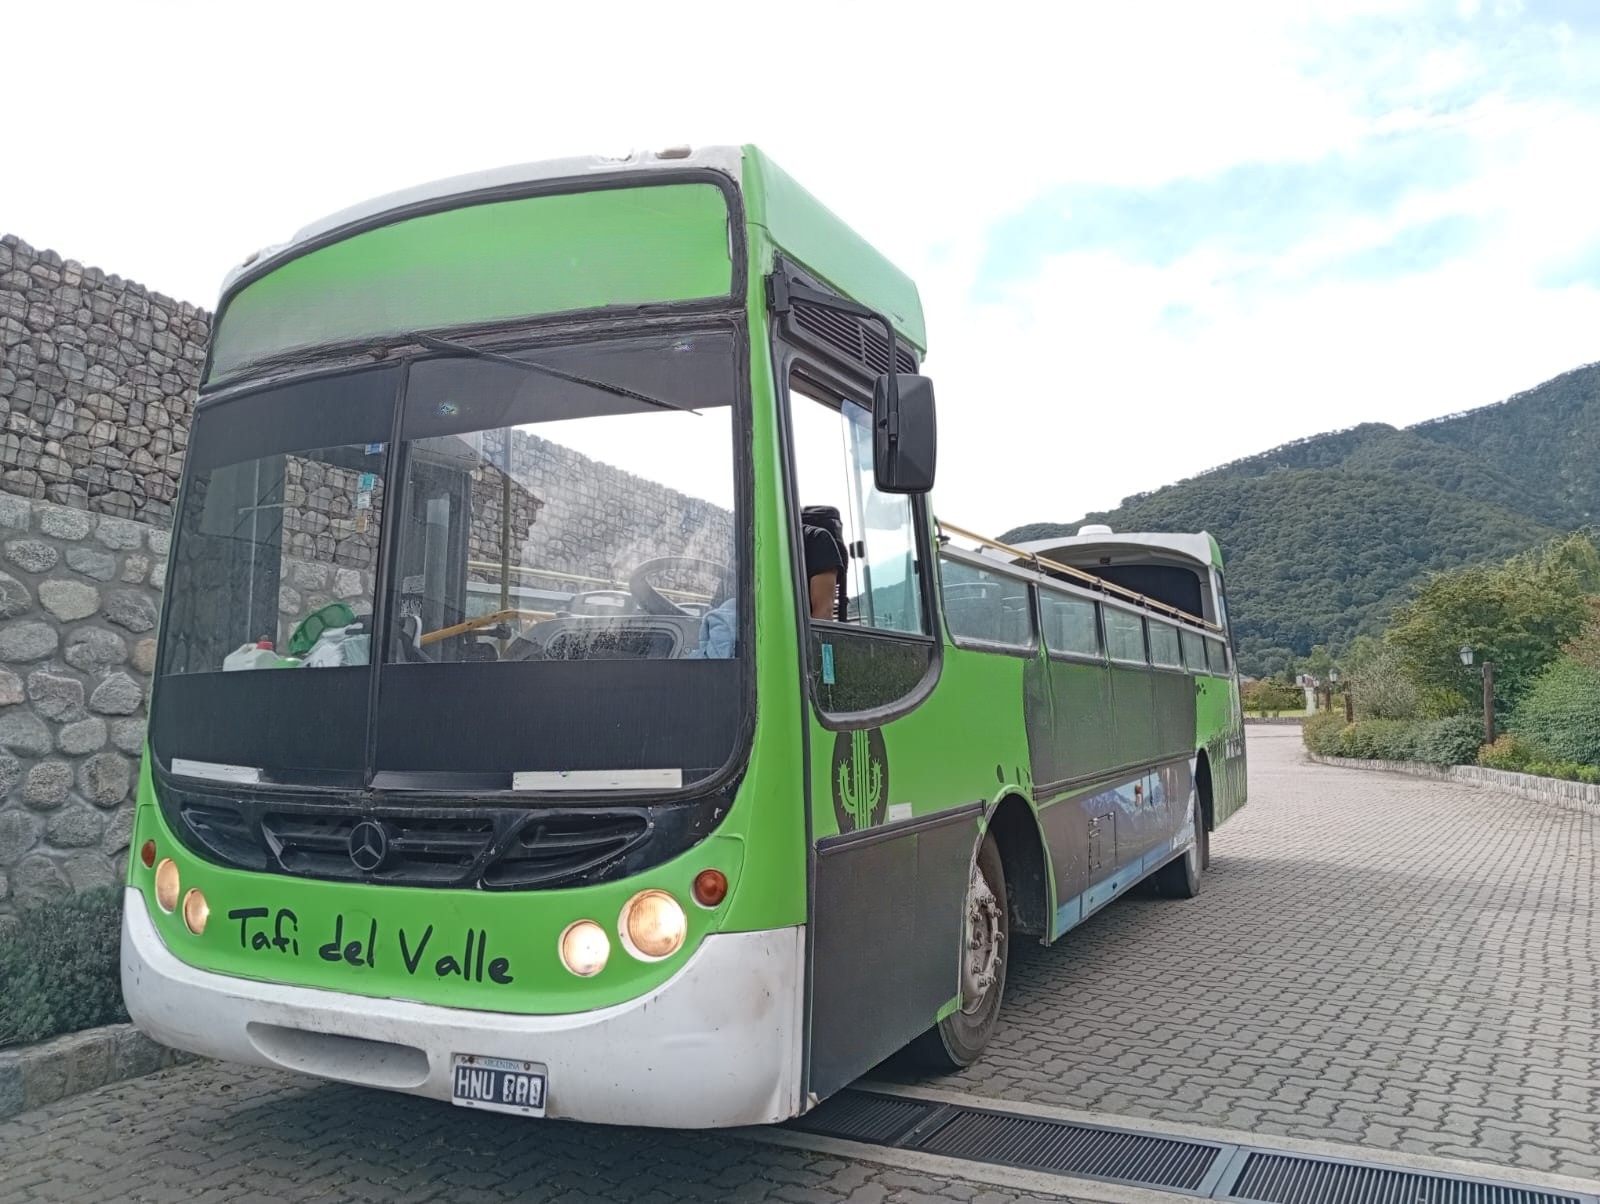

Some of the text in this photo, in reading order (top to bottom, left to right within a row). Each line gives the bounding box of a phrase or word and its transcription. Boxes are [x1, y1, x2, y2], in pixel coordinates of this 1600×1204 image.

[318, 914, 377, 969] del
[399, 924, 514, 985] Valle
[457, 1068, 496, 1100] HNU
